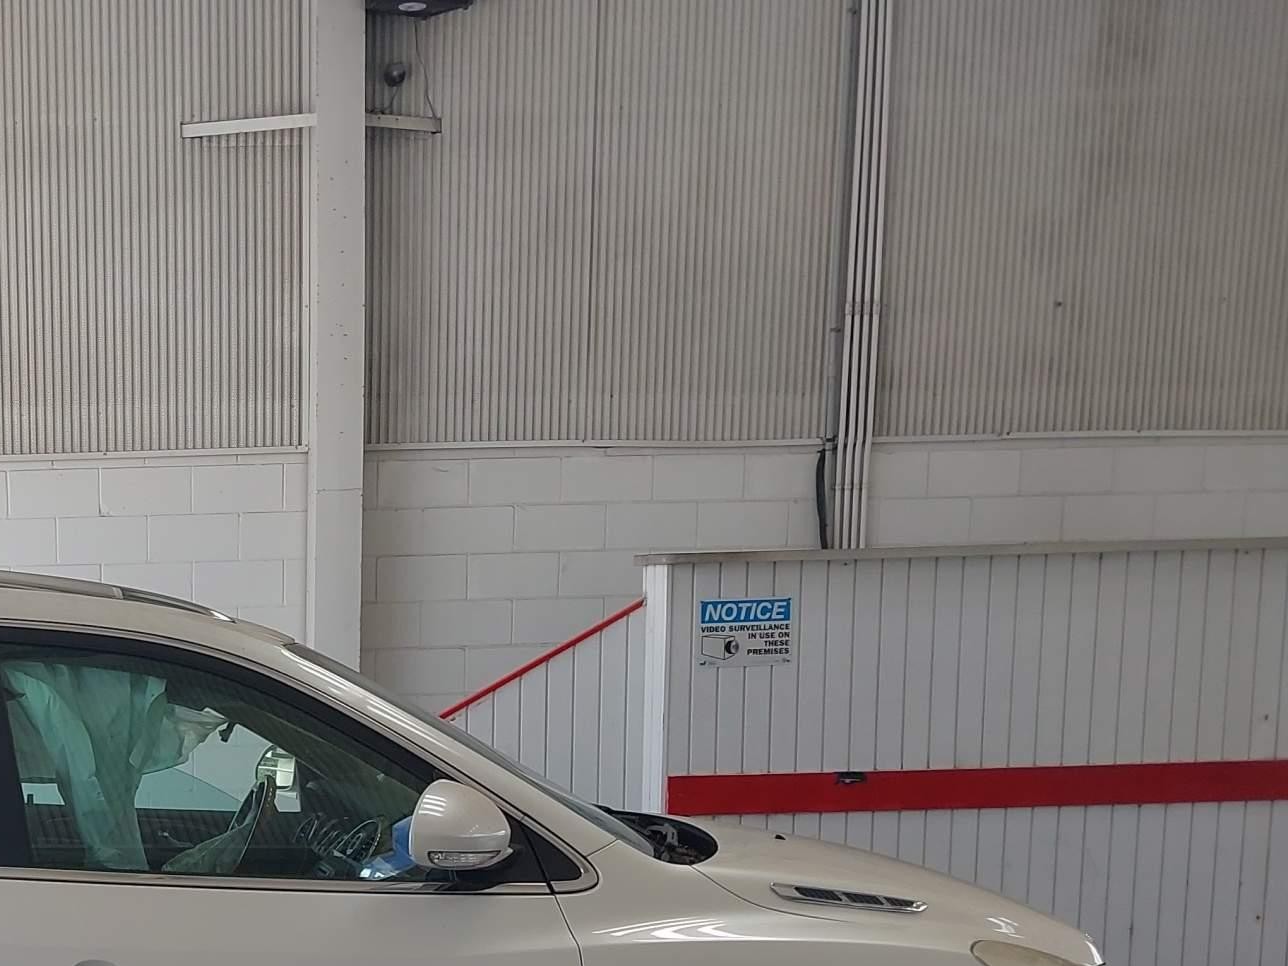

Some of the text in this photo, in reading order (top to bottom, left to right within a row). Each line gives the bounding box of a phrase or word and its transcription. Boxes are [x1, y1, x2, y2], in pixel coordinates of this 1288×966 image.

[704, 601, 787, 621] NOTICE
[701, 623, 790, 633] VIDEO SURVEILLANCE
[778, 631, 790, 639] ON
